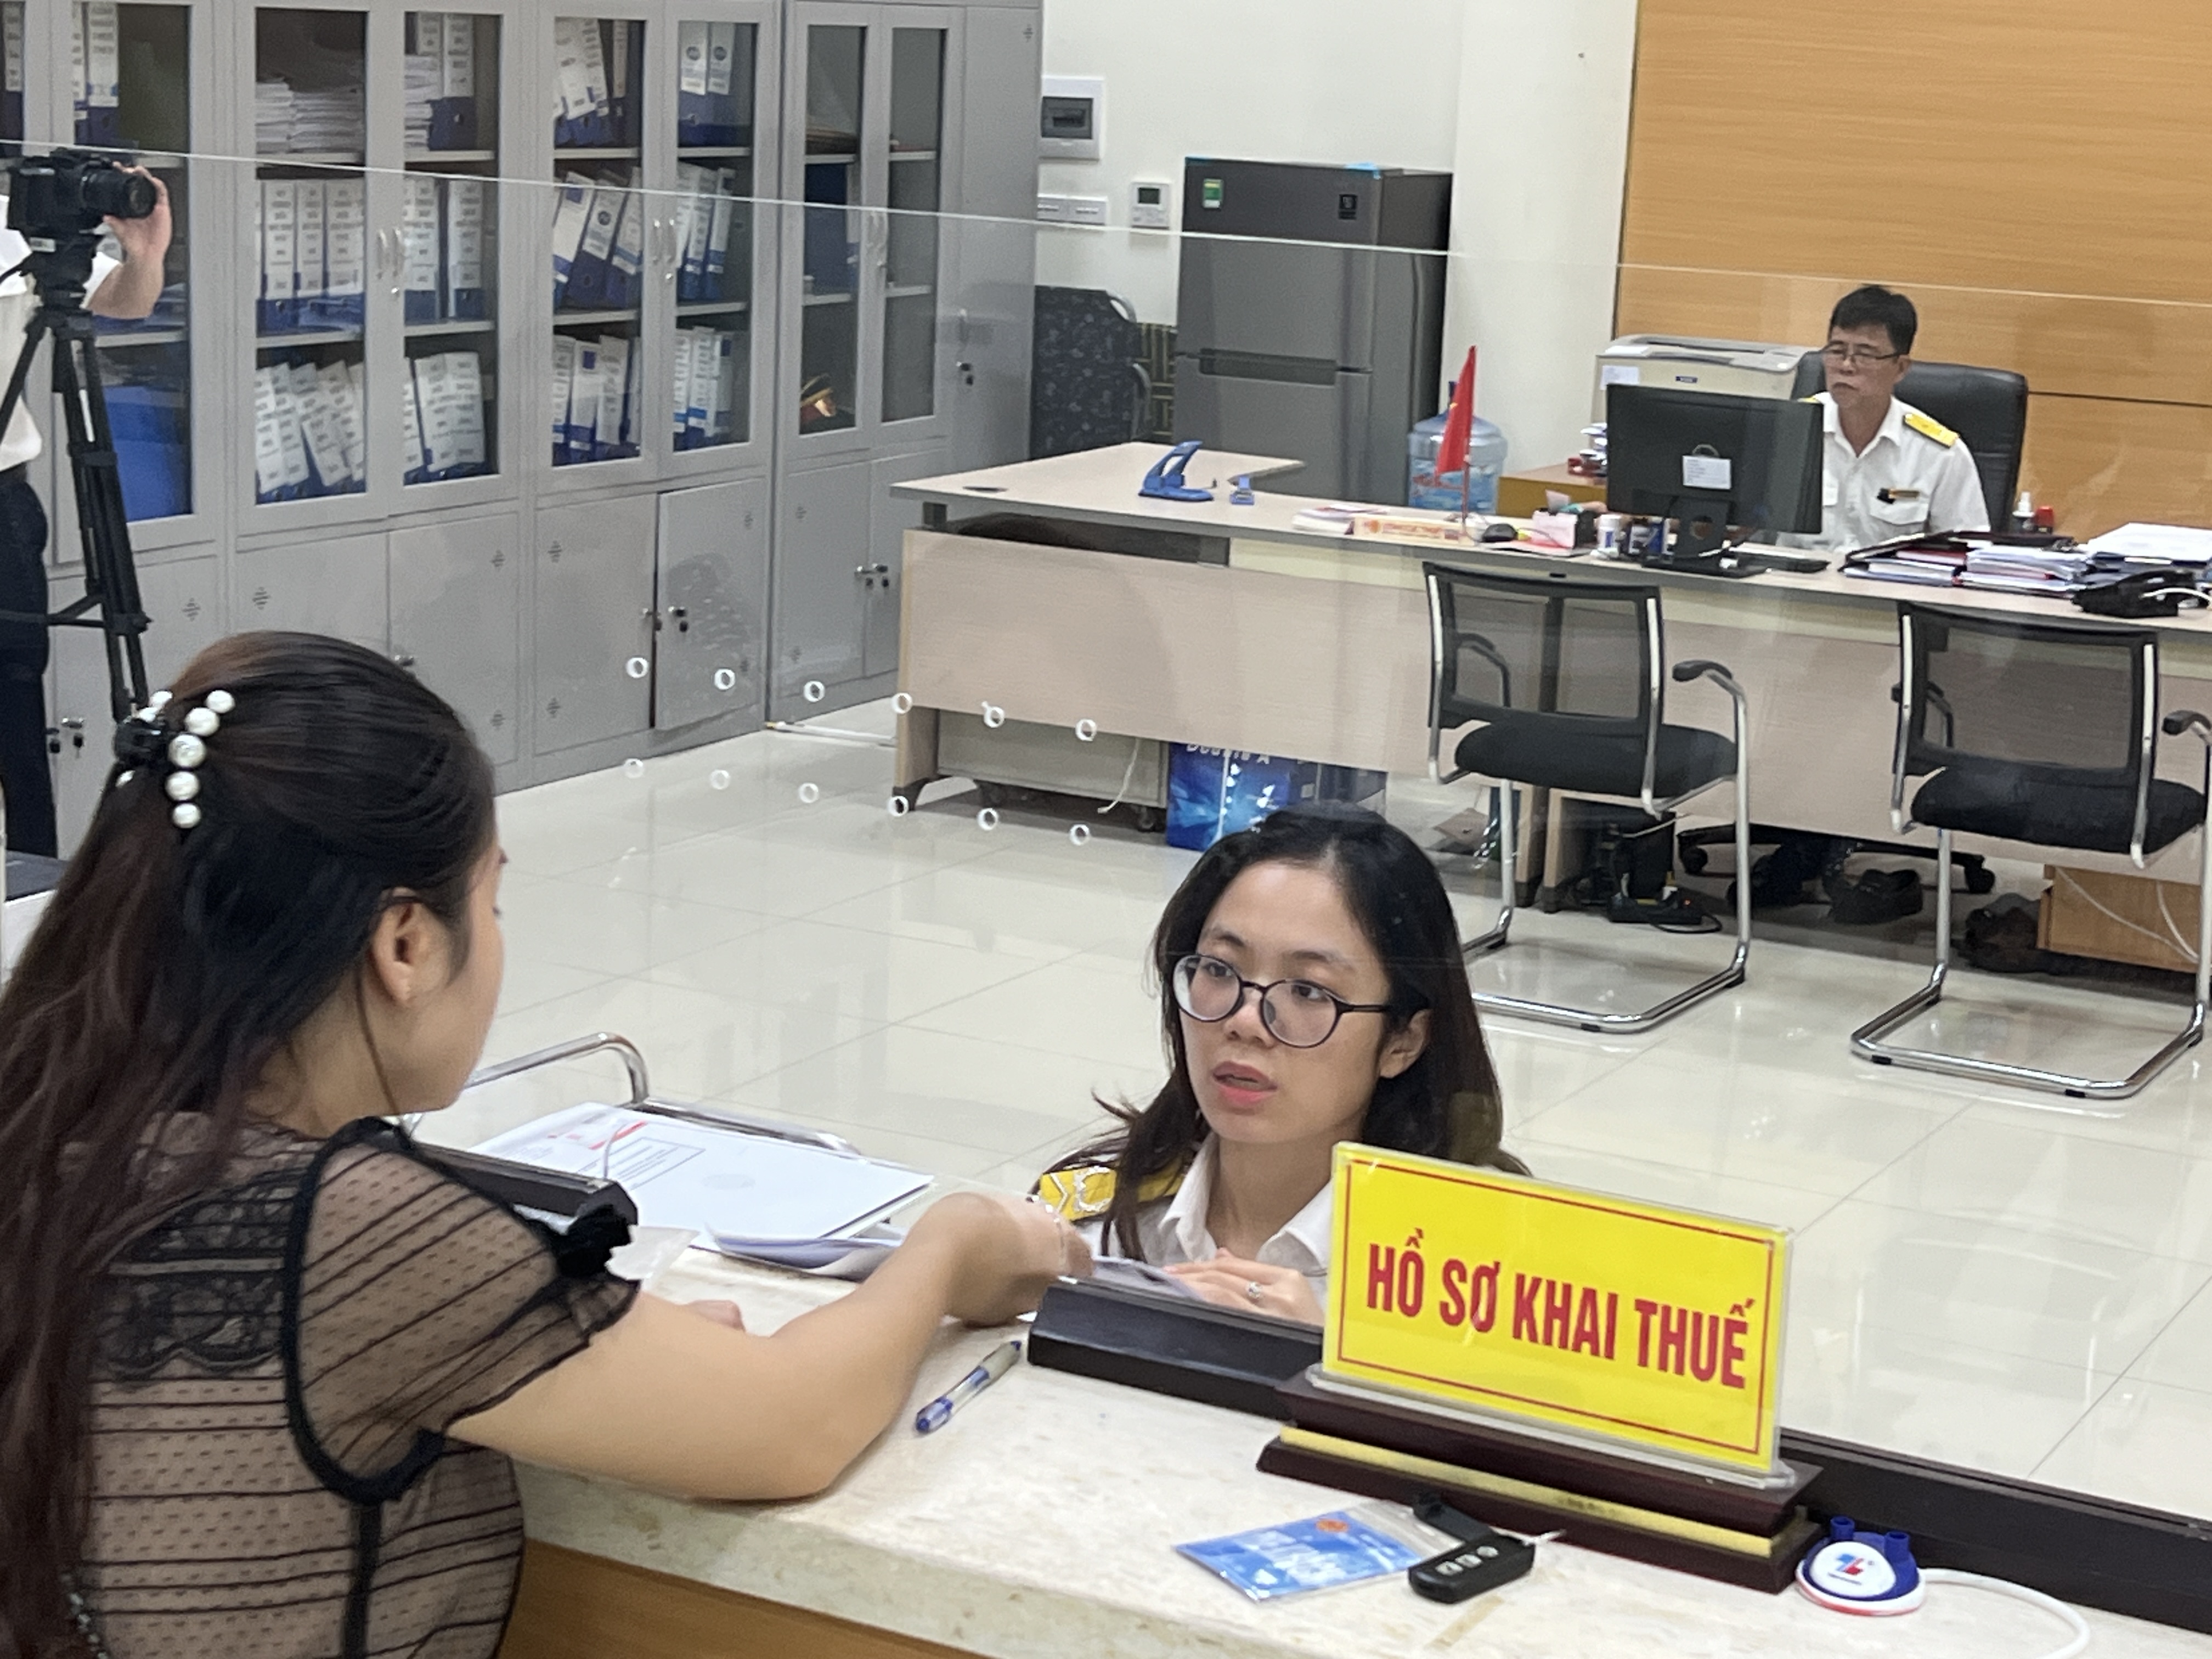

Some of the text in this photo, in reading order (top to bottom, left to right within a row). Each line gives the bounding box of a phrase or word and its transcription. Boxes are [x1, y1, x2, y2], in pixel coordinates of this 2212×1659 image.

[1367, 1227, 1755, 1389] HỒ SƠ KHAI THUẾ
